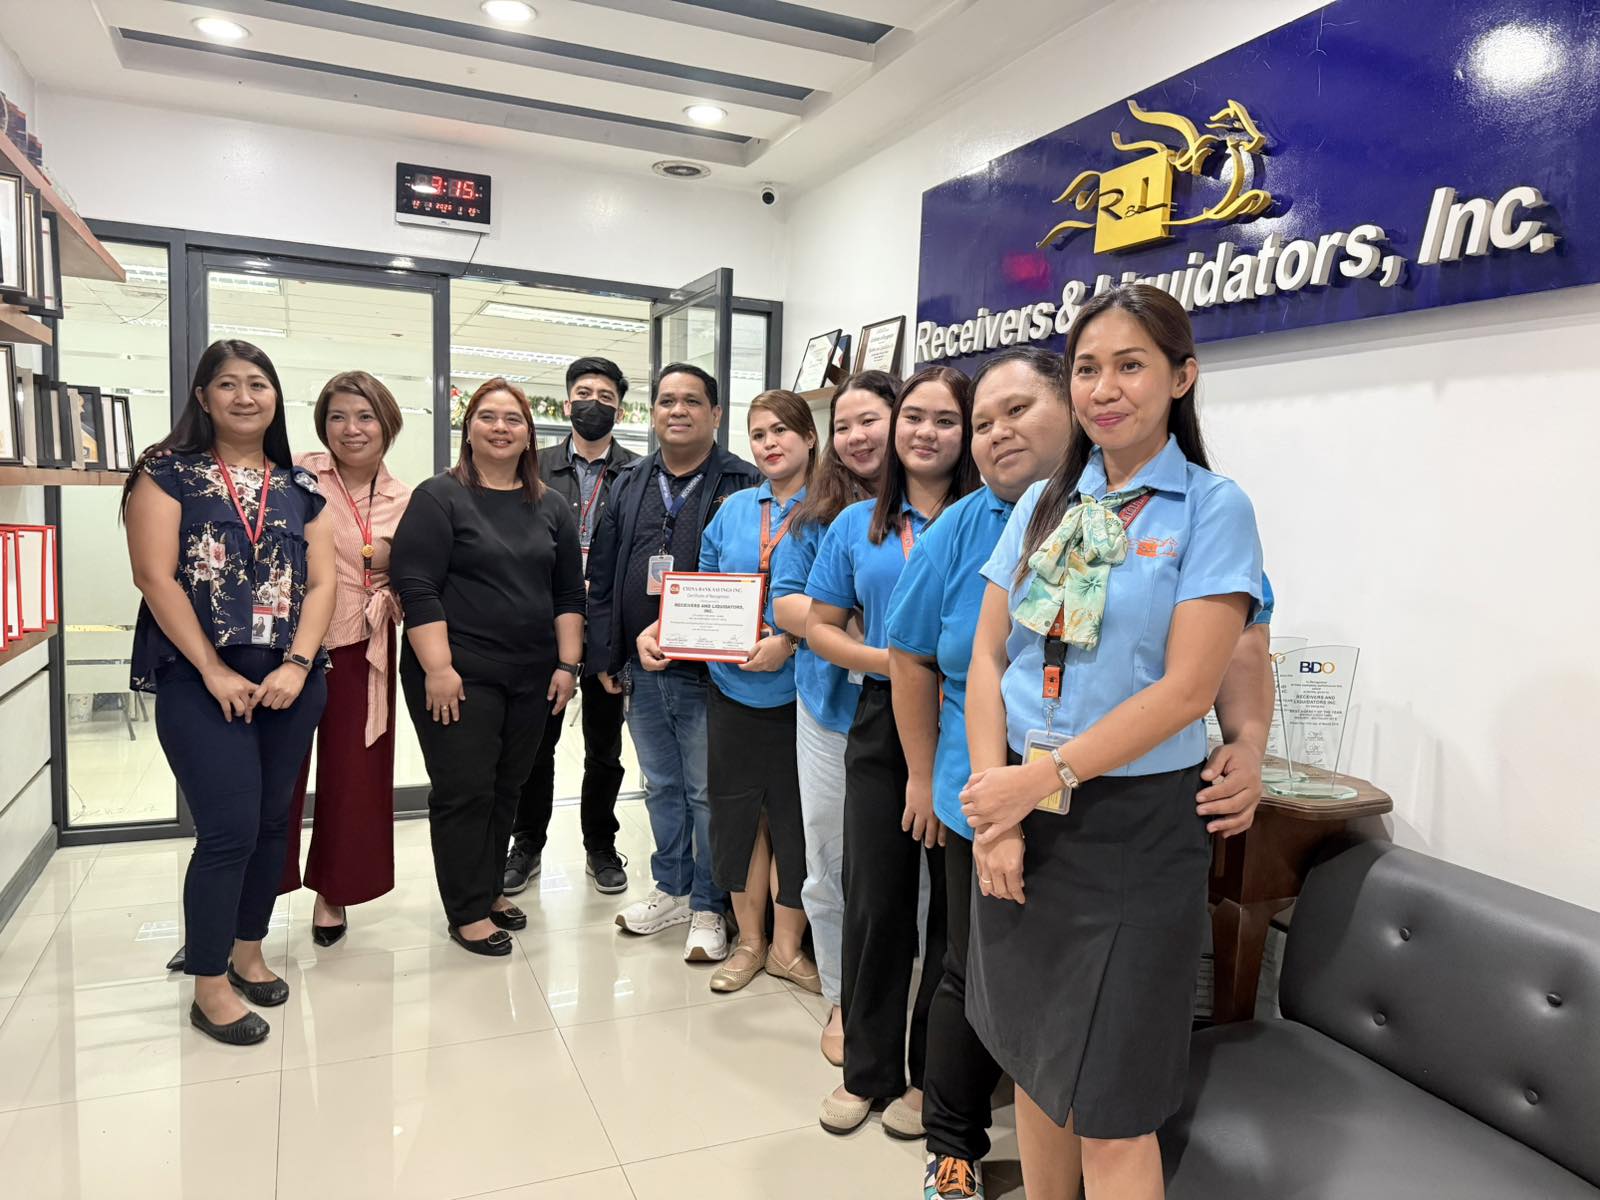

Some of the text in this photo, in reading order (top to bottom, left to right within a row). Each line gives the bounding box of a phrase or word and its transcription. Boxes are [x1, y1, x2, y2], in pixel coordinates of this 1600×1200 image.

[915, 302, 1055, 363] Receivers
[1054, 280, 1085, 334] &
[1417, 186, 1555, 265] Inc.
[1299, 661, 1335, 674] BDO
